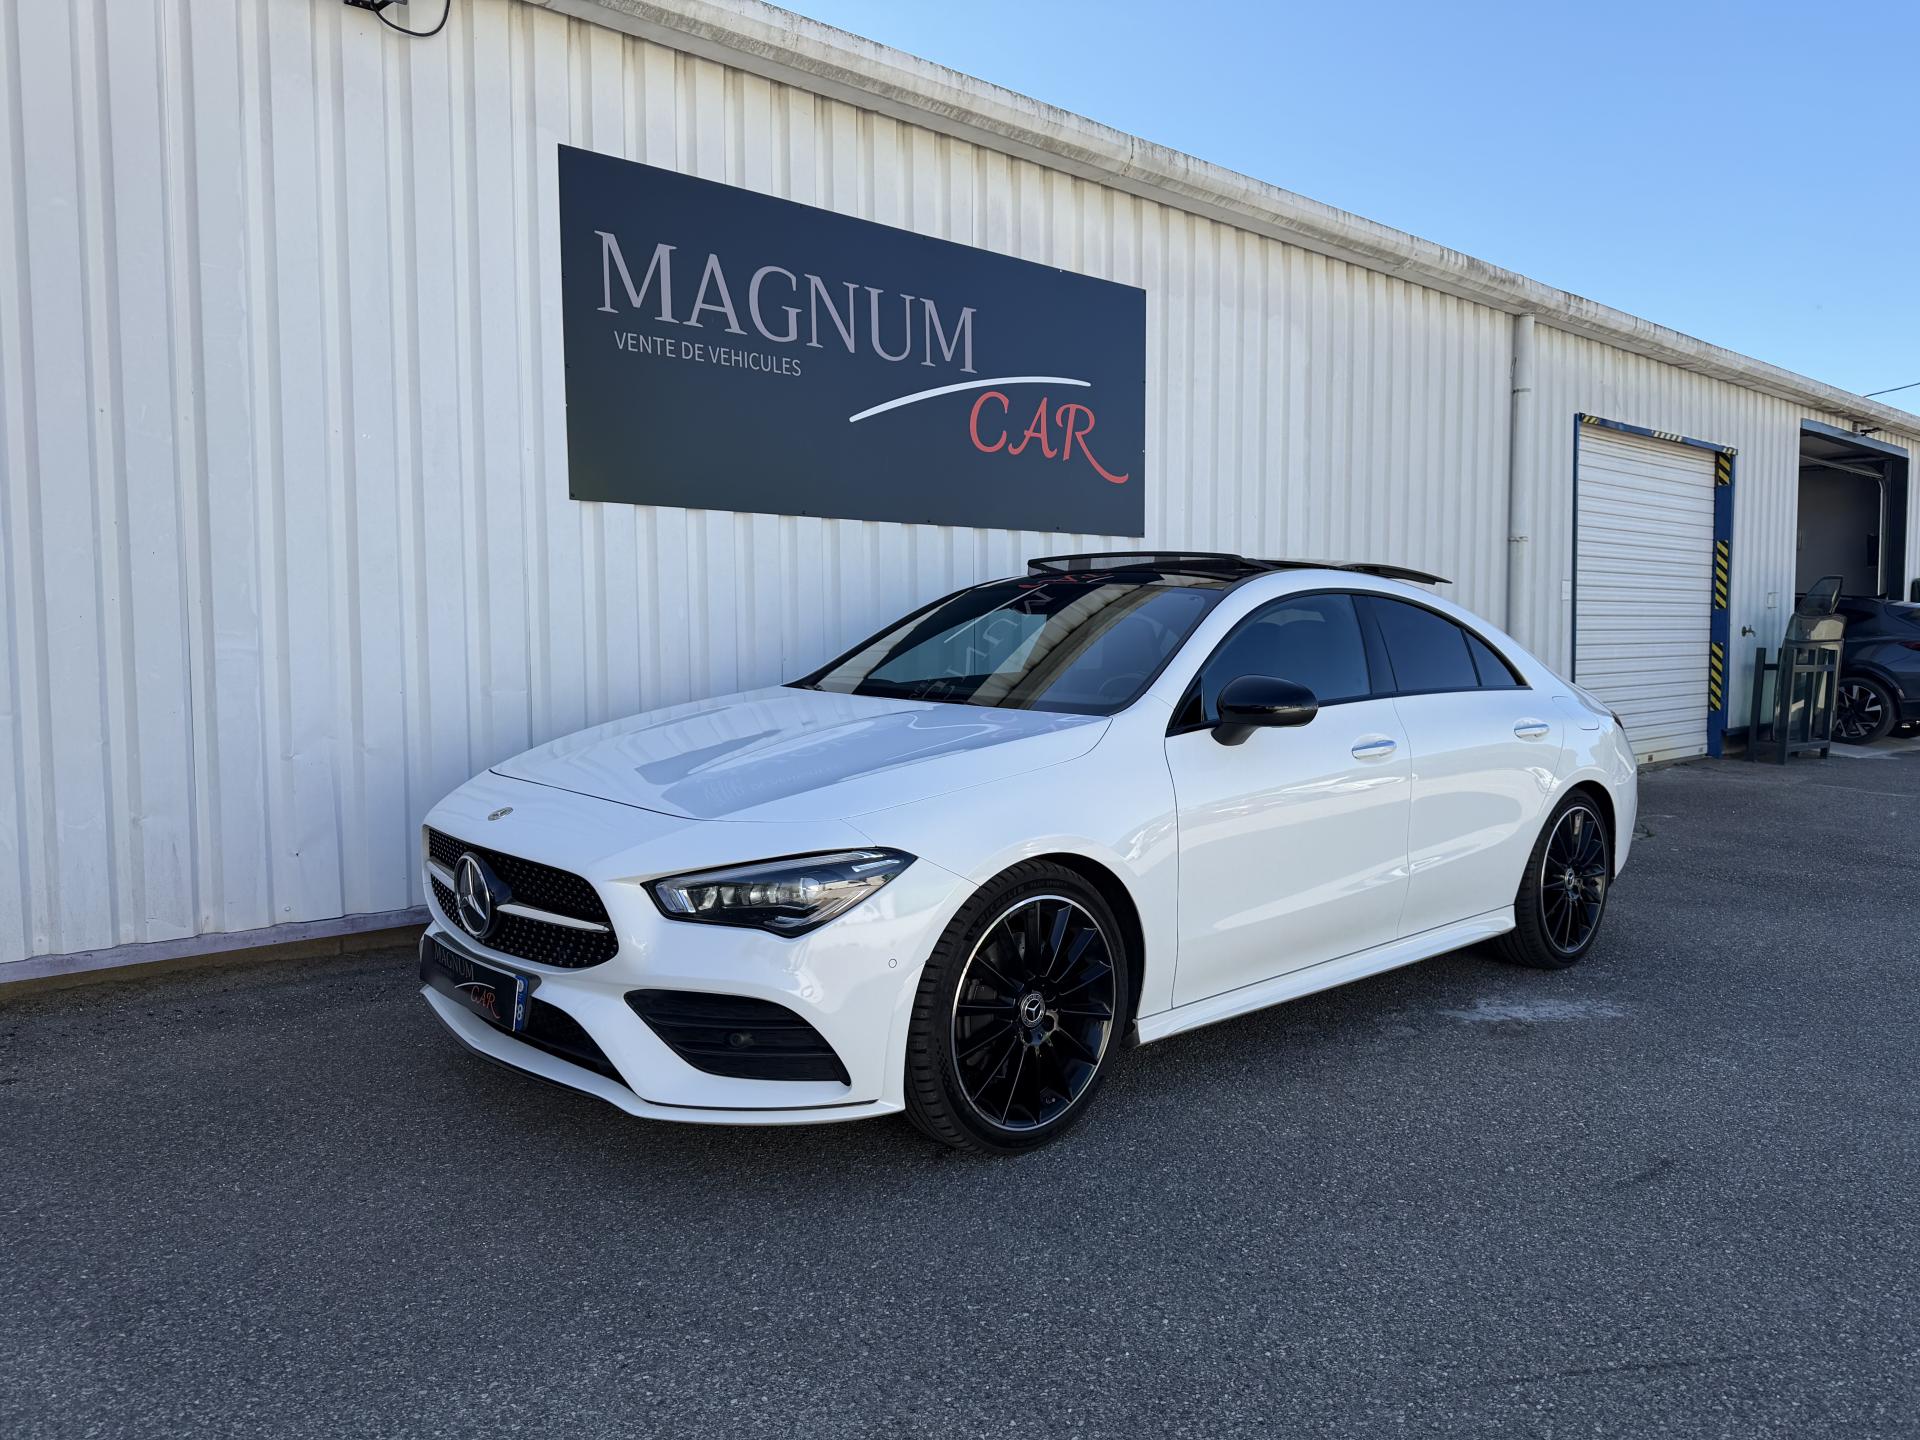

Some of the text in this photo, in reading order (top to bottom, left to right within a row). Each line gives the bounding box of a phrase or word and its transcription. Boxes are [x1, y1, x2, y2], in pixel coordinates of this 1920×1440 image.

[594, 230, 977, 374] MAGNUM
[614, 330, 802, 377] VENTE DE VEHICULES
[970, 391, 1129, 484] CAR
[434, 943, 474, 980] MAGNUM
[470, 985, 501, 1018] CAR
